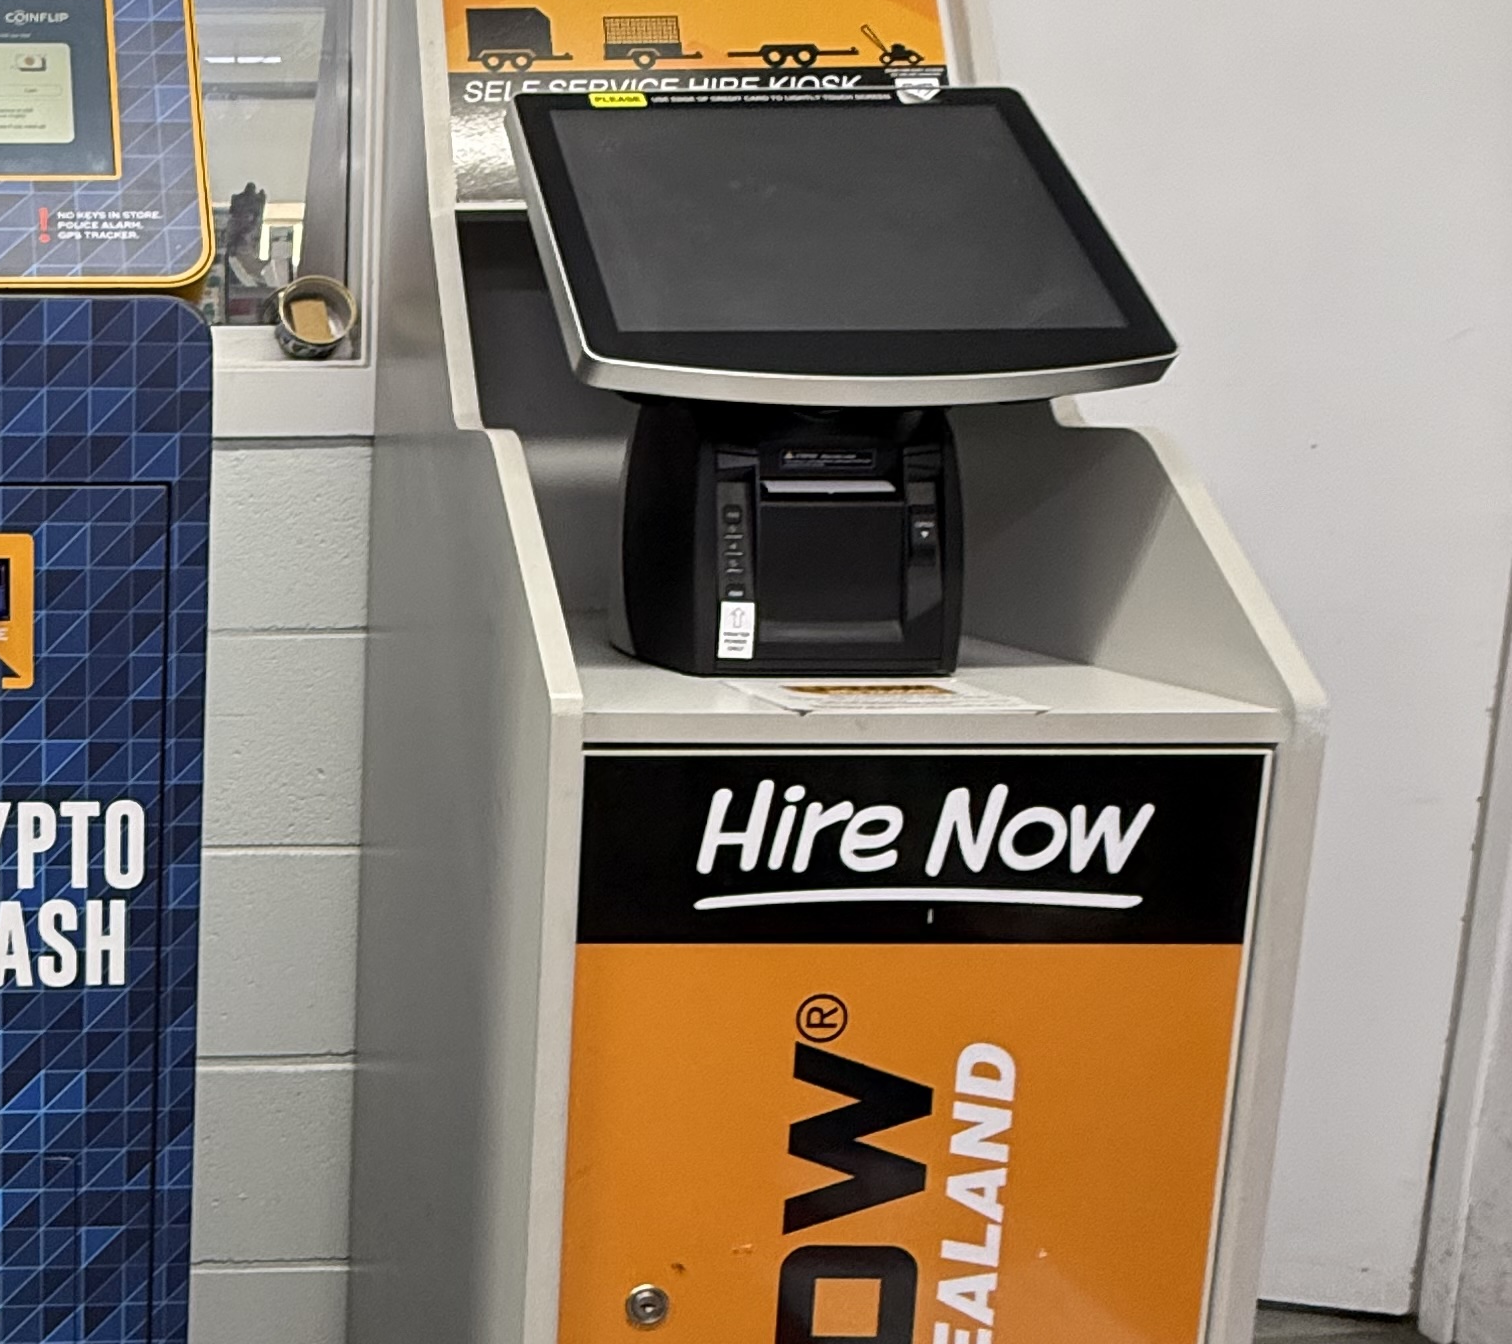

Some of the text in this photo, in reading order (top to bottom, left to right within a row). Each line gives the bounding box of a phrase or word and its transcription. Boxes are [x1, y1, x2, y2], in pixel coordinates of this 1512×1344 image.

[4, 10, 70, 25] COINFLIP
[57, 211, 75, 219] NO
[108, 211, 121, 219] IN
[57, 221, 99, 229] POLICE
[57, 231, 82, 239] GPS
[695, 779, 1156, 878] Hire Now
